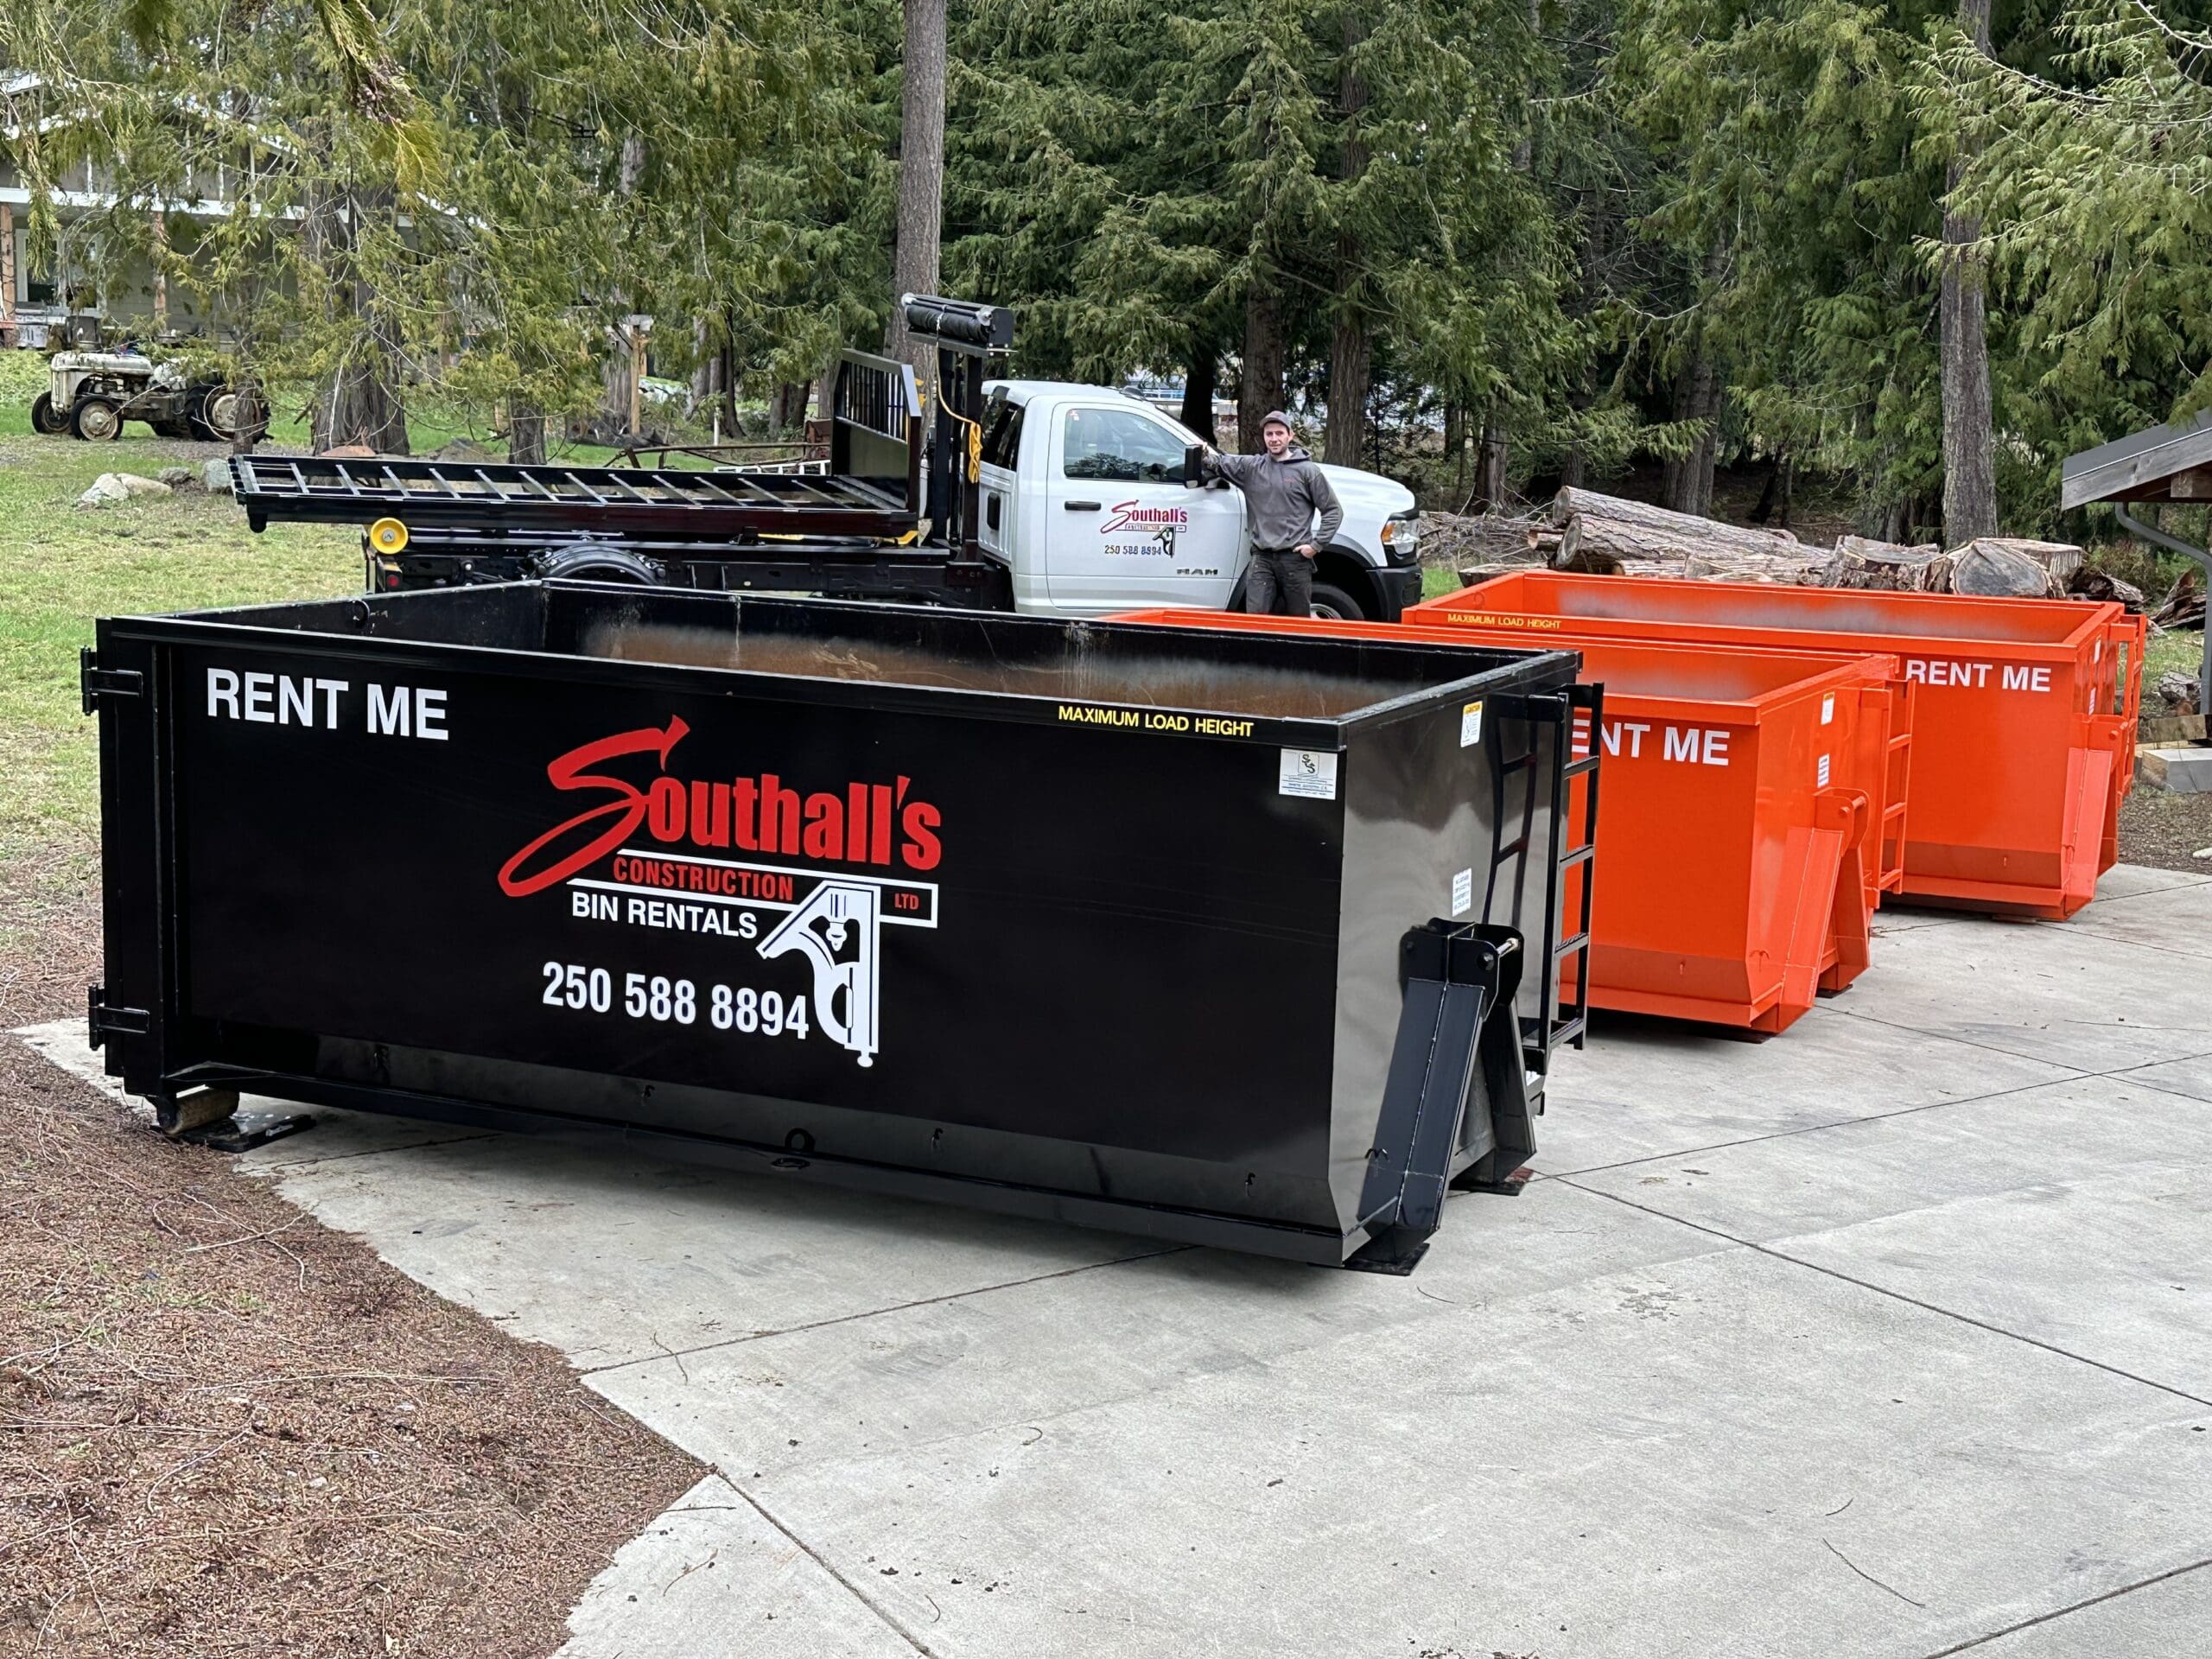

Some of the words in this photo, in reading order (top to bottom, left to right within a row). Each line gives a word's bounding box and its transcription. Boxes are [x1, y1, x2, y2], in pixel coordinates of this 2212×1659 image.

[1100, 499, 1188, 534] Southall's
[1104, 544, 1121, 555] 250
[1447, 613, 1495, 626] MAXIMUM
[1498, 617, 1524, 626] LOAD
[1527, 619, 1561, 630] HEIGHT
[1906, 659, 1993, 688] RENT
[2002, 665, 2051, 692] ME
[207, 668, 349, 729] RENT
[367, 683, 448, 741] ME
[1058, 705, 1139, 727] MAXIMUM
[1145, 714, 1189, 731] LOAD
[1195, 718, 1254, 736] HEIGHT
[1572, 719, 1650, 758] ENT
[1663, 727, 1730, 766] ME
[498, 715, 942, 898] Southall's
[613, 857, 794, 901] CONSTRUCTION
[894, 893, 919, 910] LTD
[572, 891, 619, 922] BIN
[627, 898, 758, 938] RENTALS
[543, 961, 611, 1013] 250
[625, 974, 696, 1024] 588
[711, 984, 810, 1039] 8894
